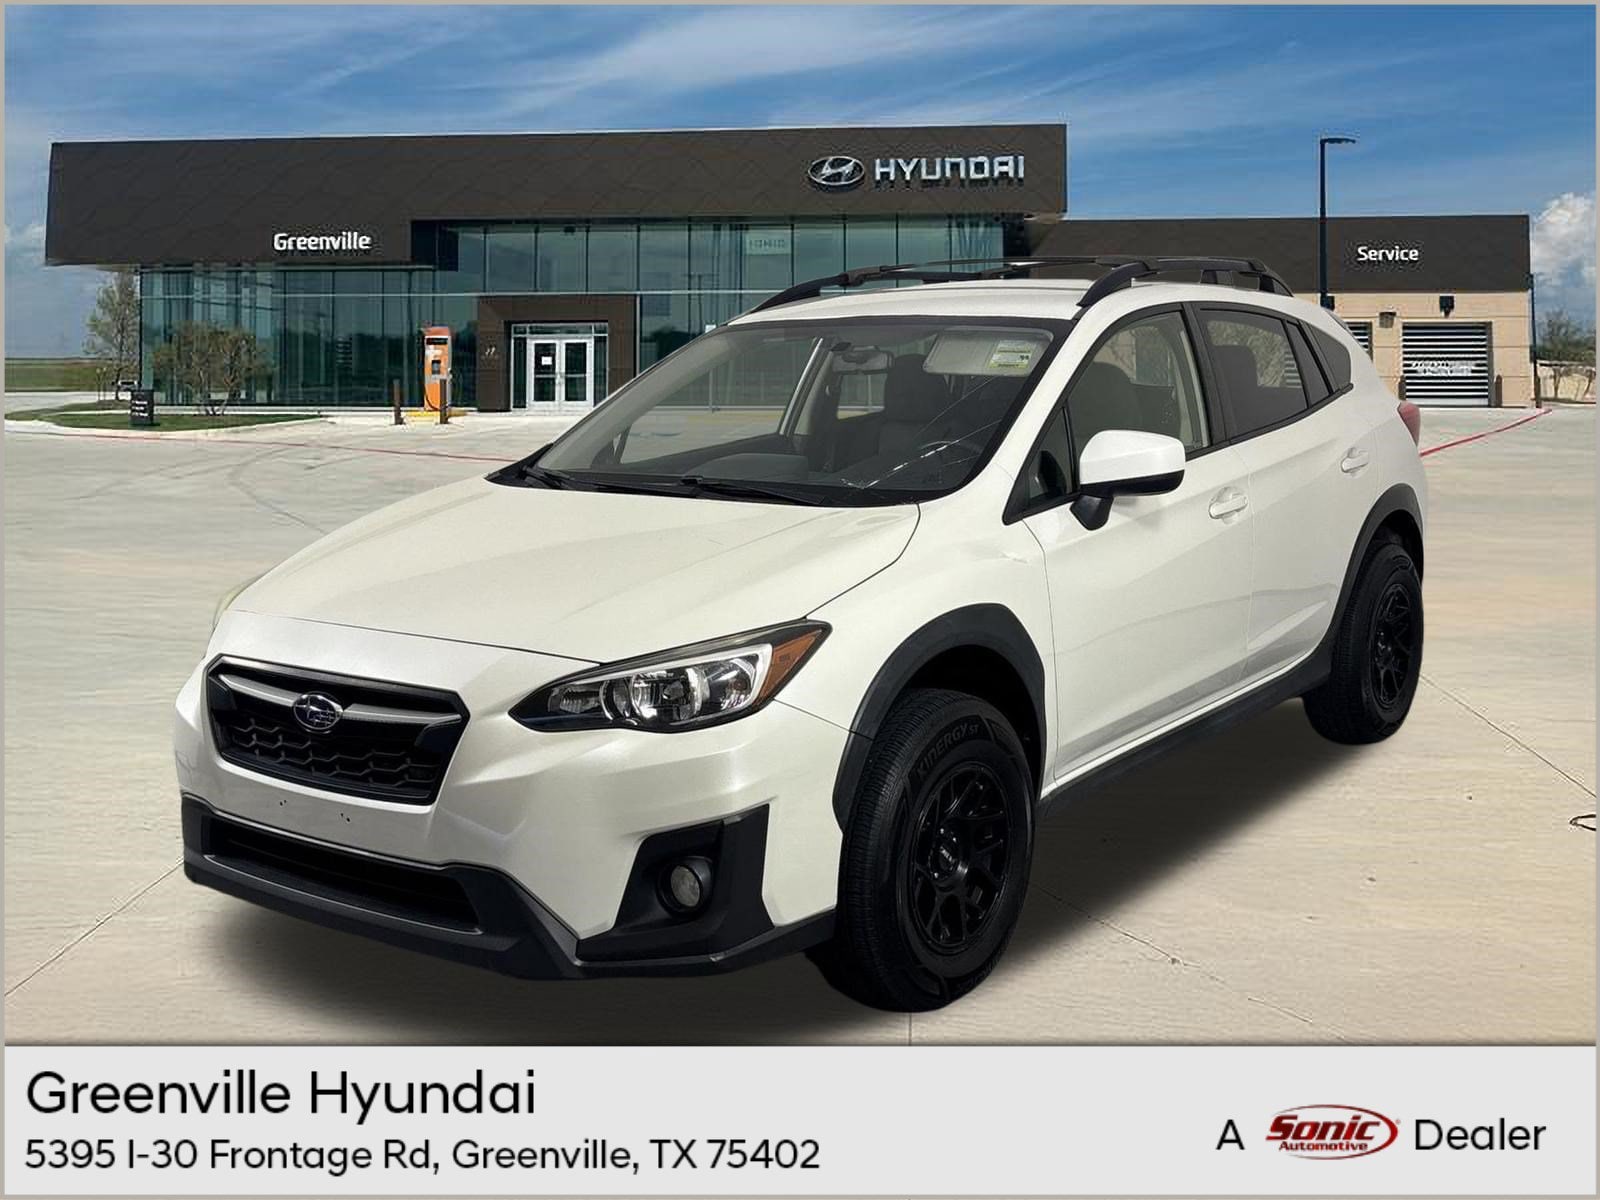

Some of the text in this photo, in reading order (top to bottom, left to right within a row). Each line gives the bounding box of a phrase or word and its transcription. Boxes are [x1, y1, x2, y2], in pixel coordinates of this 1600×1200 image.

[875, 155, 1025, 180] HYUNDAI
[273, 230, 372, 251] Greenville
[1356, 245, 1420, 263] Service
